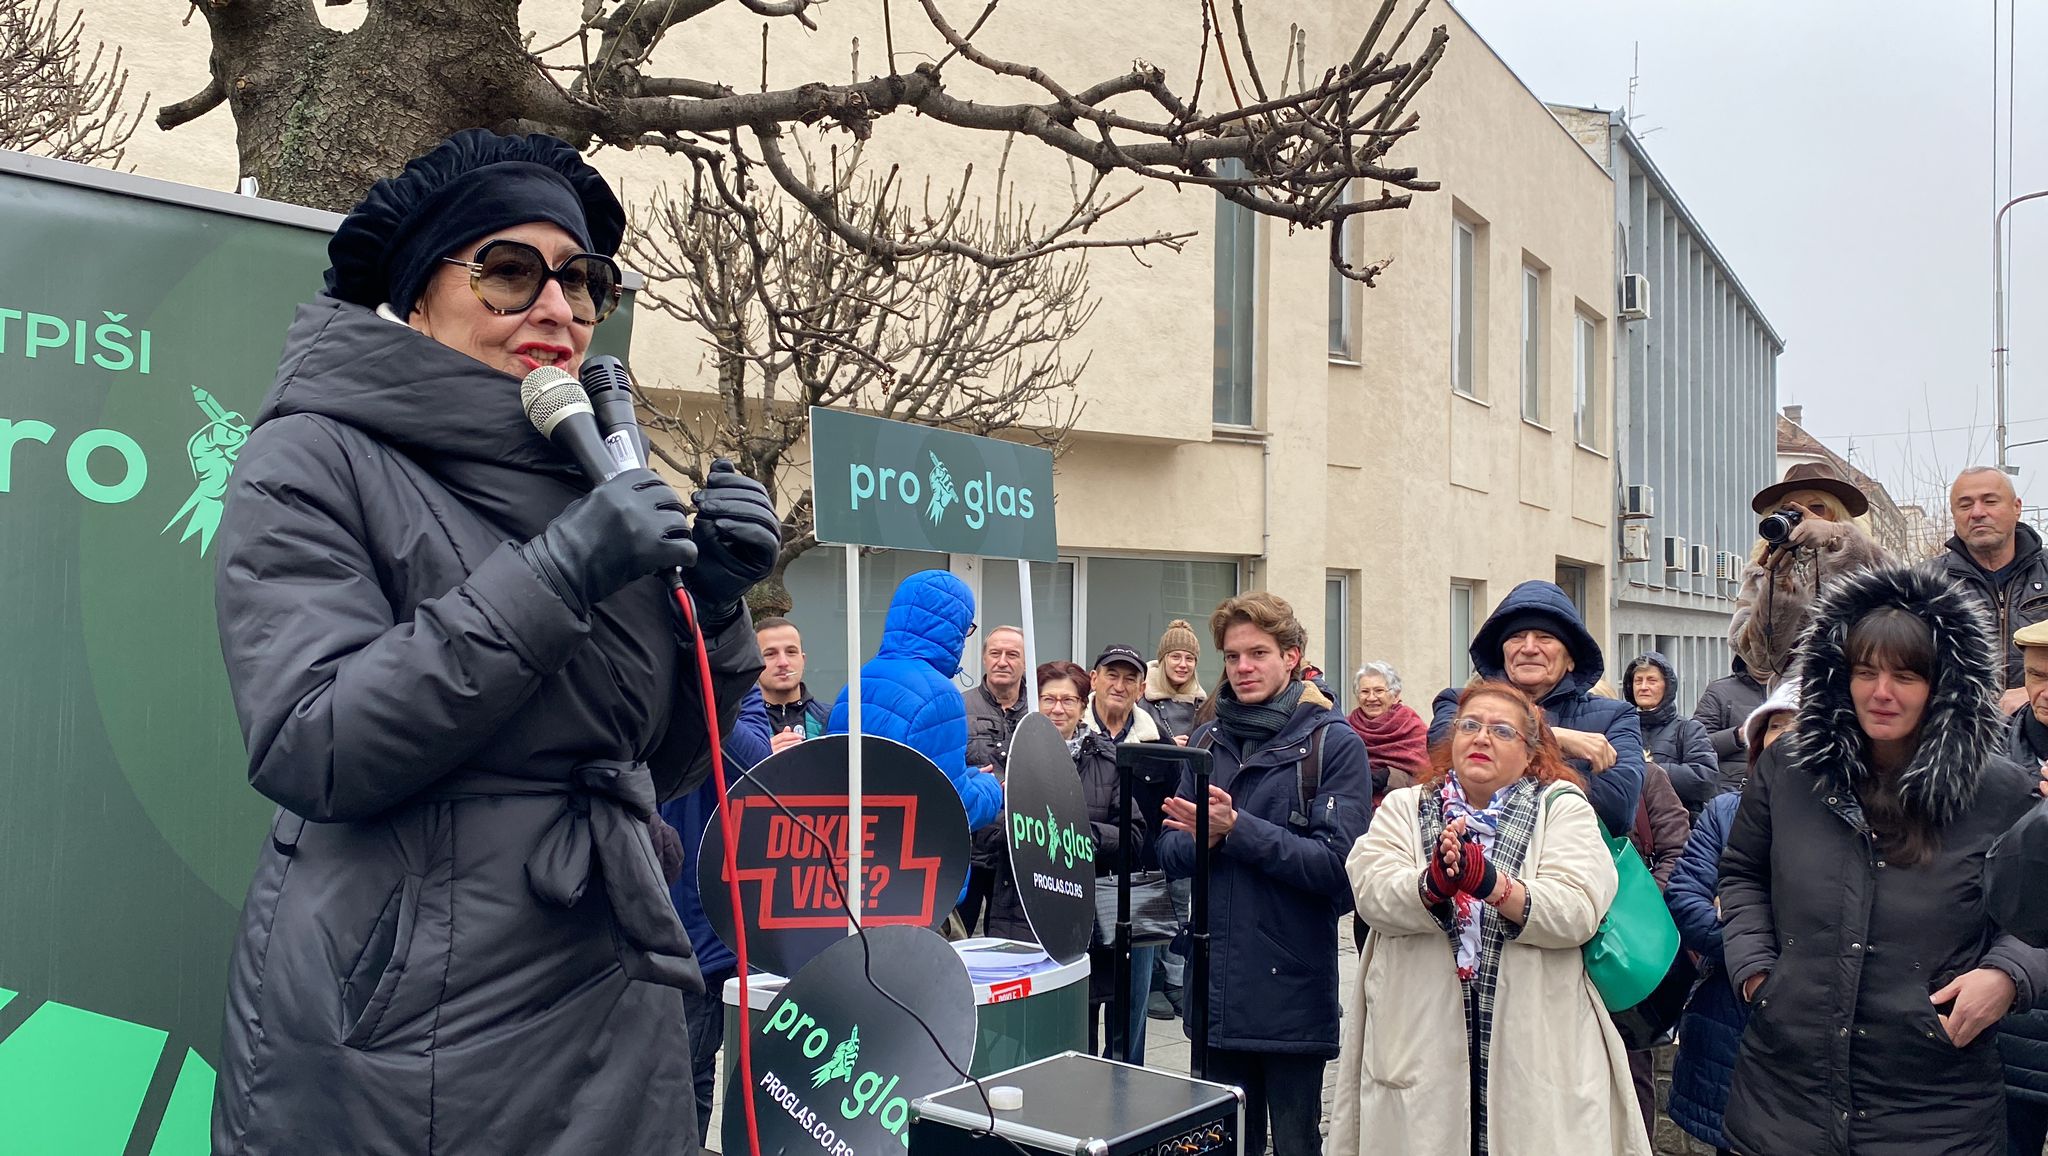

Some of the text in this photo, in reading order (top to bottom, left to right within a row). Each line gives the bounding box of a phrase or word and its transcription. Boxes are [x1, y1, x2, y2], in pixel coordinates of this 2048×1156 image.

[850, 463, 1035, 530] pro glas
[766, 814, 879, 859] DOKLE
[1013, 812, 1094, 869] pro glas
[1033, 872, 1083, 899] PROGLAS.CO.RS
[762, 998, 829, 1059] pro
